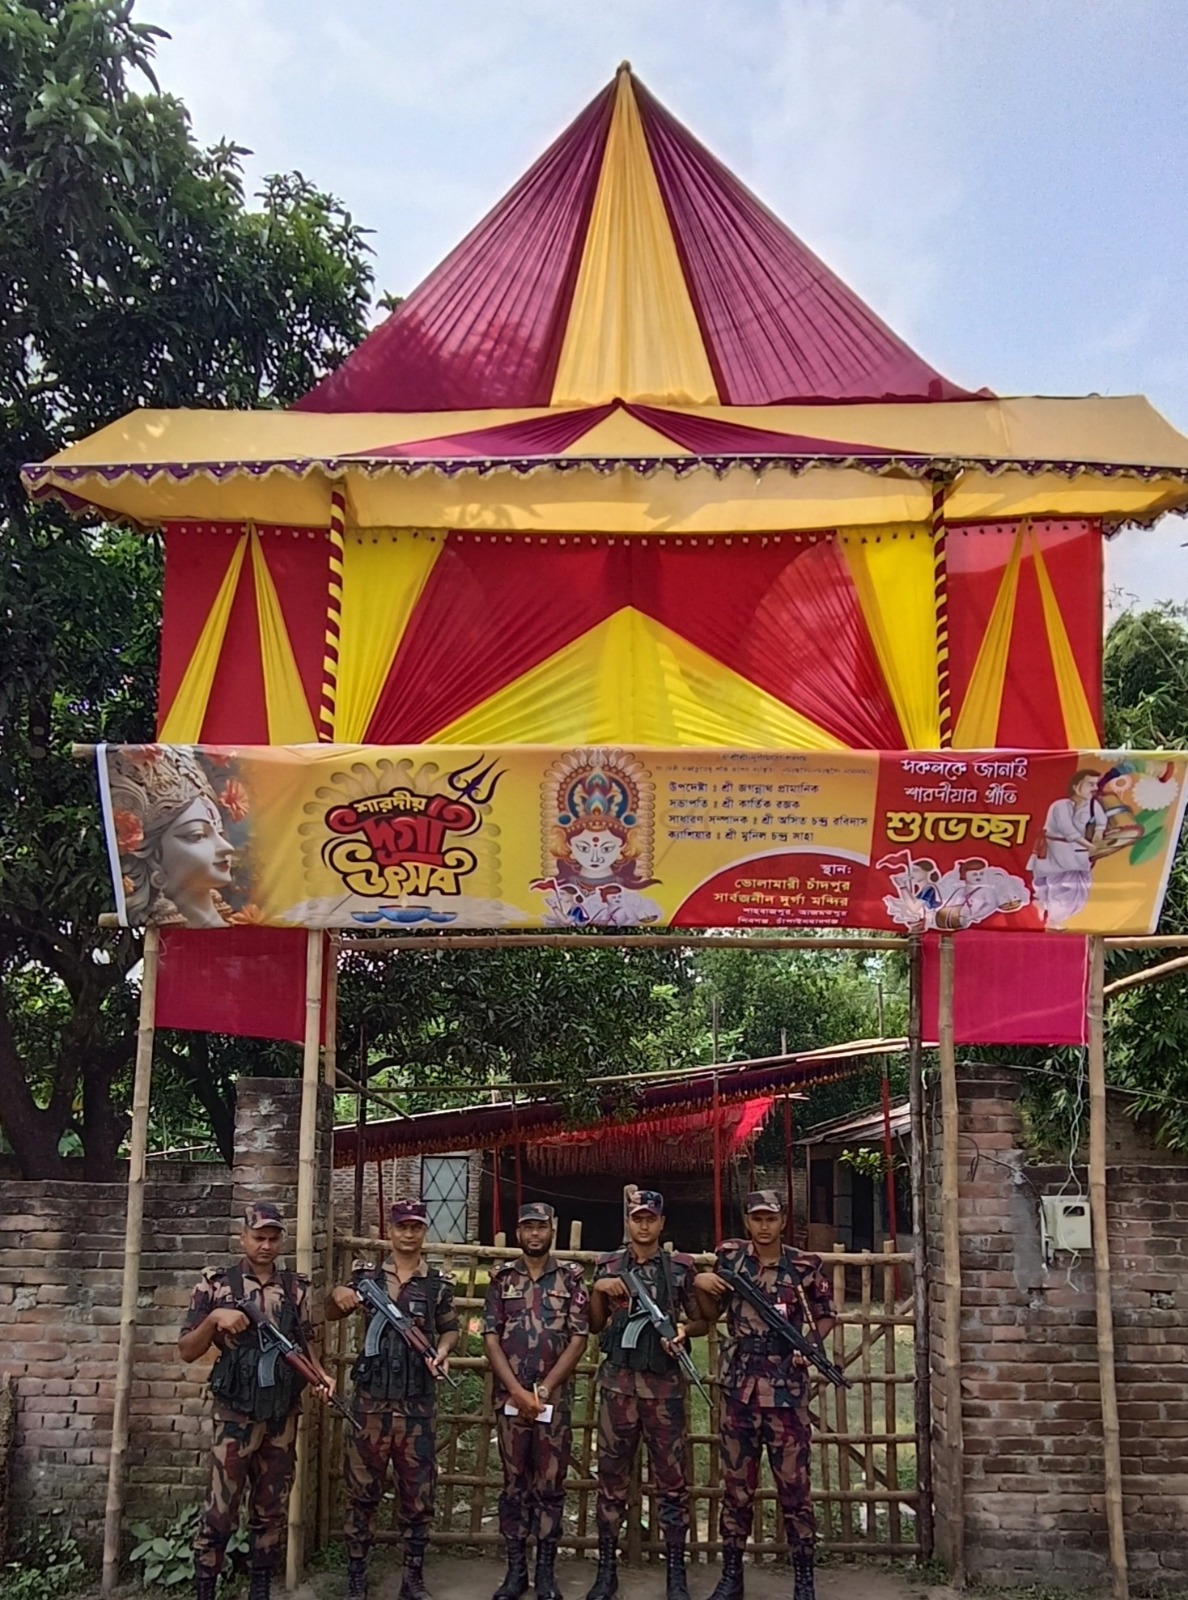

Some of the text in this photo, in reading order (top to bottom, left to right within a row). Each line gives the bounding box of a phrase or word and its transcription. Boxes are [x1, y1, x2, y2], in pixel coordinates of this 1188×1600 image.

[900, 758, 967, 780] সকলকে
[972, 757, 1028, 781] জানাই
[668, 780, 708, 793] উপদেষ্টা
[721, 780, 733, 793] শ্রী
[904, 781, 1018, 806] শারদীয়ার প্রীতি
[353, 790, 428, 812] শারদীয়
[669, 797, 708, 809] সভাপতি
[722, 796, 733, 809] শ্রী
[738, 797, 771, 809] কার্তিক
[776, 800, 800, 809] রজক
[668, 815, 703, 825] সাধারণ
[761, 813, 772, 825] শ্রী
[778, 814, 806, 826] অসিত
[833, 815, 868, 827] রবিদাস
[885, 810, 1031, 848] শুভেচ্ছা
[725, 827, 736, 840] শ্রী
[329, 840, 477, 897] উৎসব
[806, 878, 851, 893] চাঁদপুর
[713, 890, 849, 908] সার্বজনীন দুর্গা মন্দির
